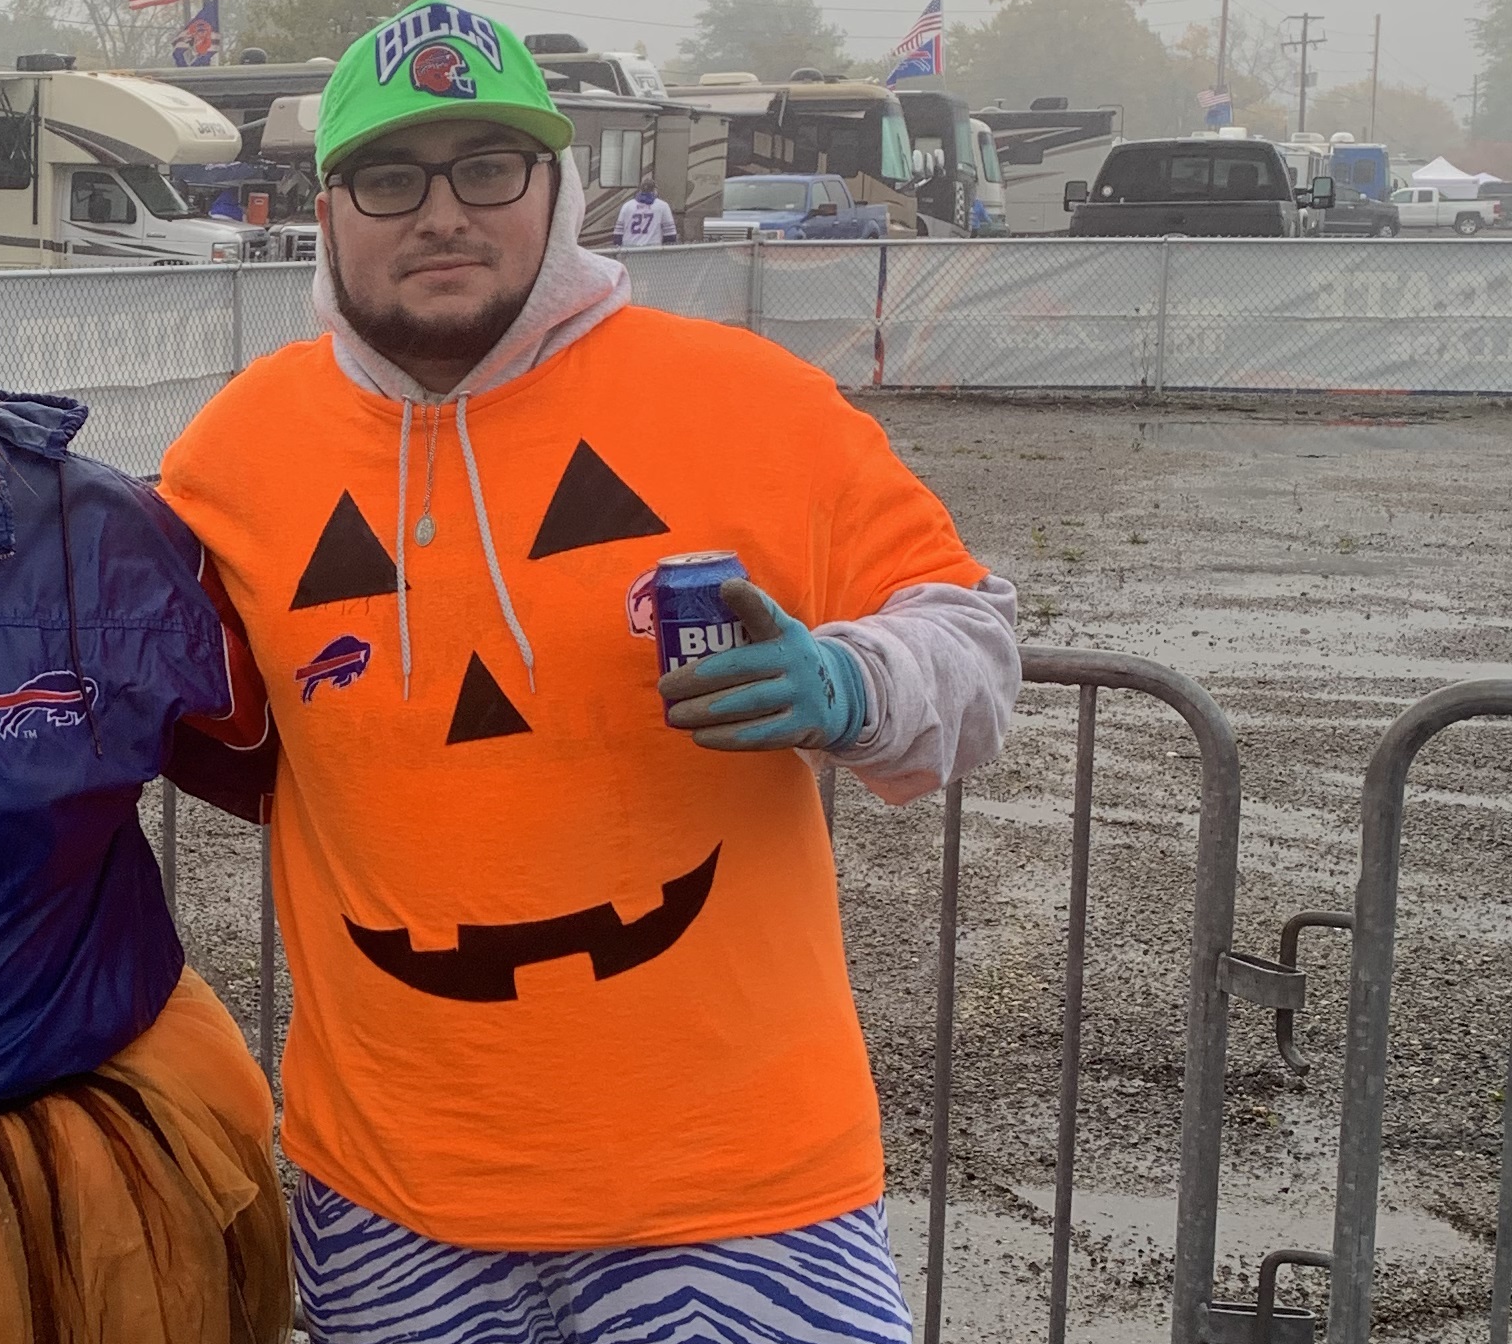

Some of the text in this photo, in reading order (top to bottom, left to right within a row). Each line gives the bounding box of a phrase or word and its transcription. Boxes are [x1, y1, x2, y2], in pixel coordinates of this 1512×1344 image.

[376, 5, 502, 84] BILLS
[631, 213, 654, 234] 27
[22, 729, 38, 739] TM
